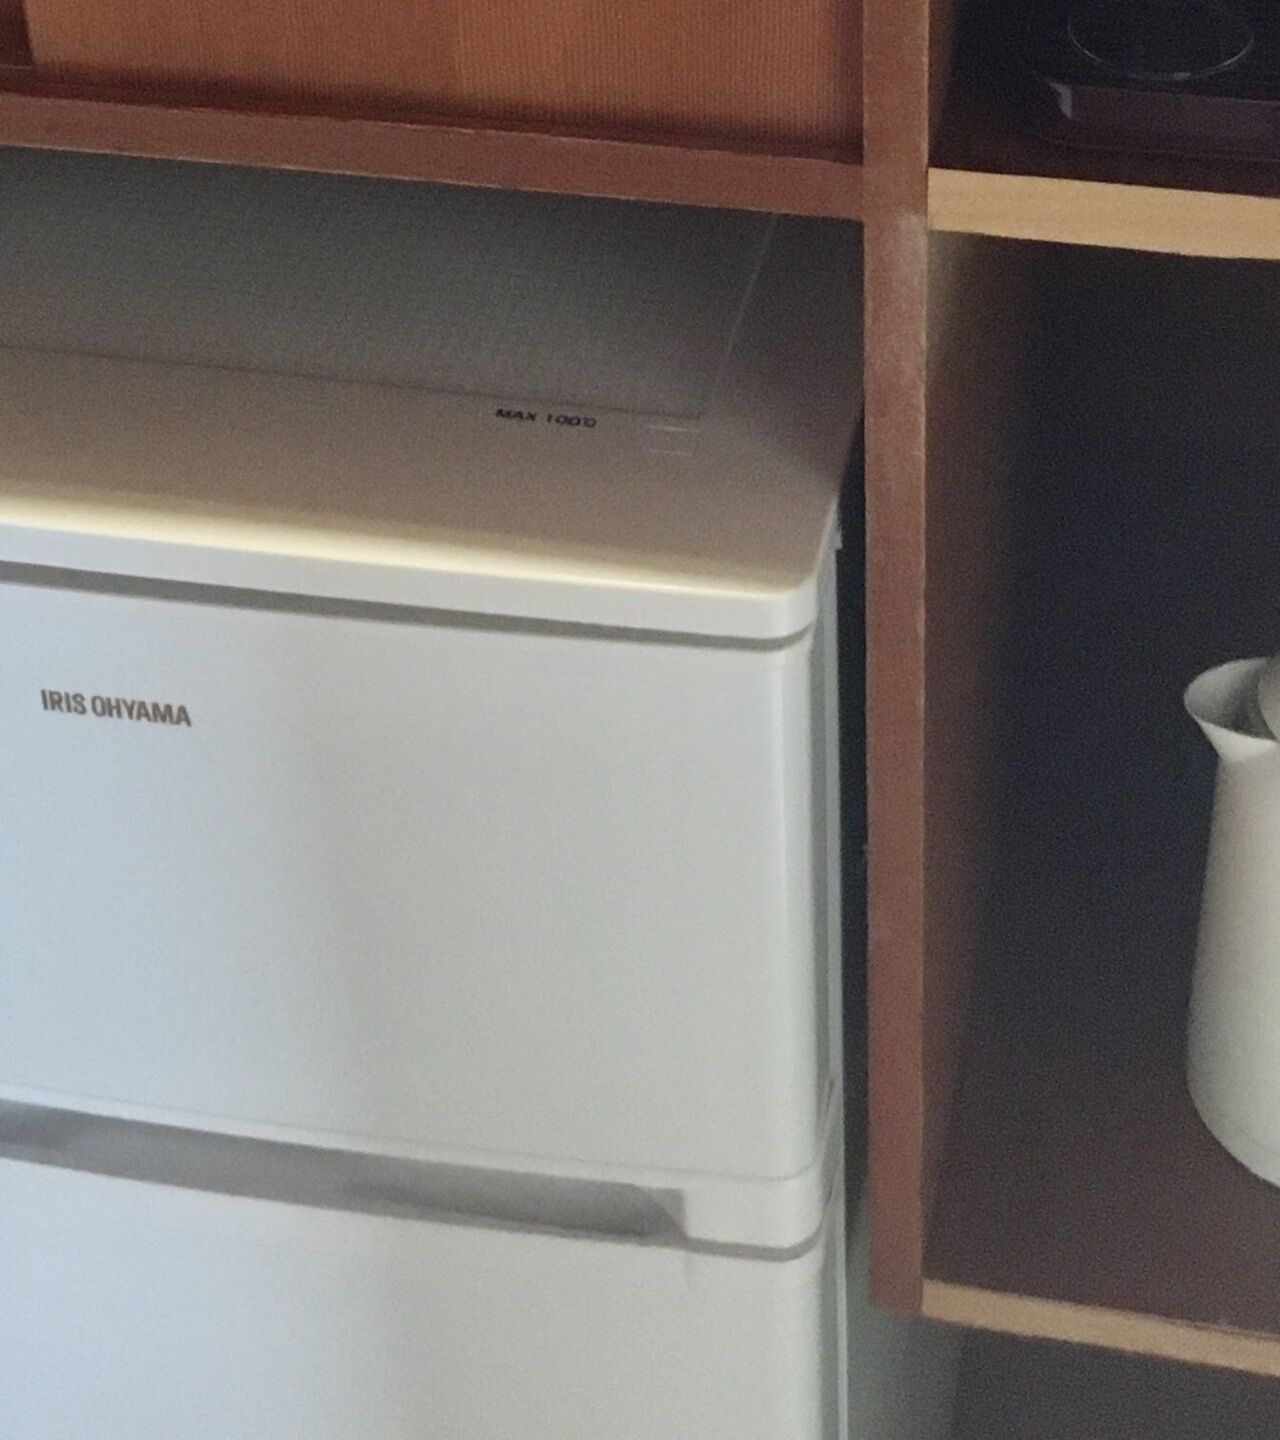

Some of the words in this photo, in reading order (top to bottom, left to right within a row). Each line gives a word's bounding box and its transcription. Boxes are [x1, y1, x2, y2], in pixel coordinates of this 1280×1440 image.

[495, 408, 537, 422] MAX
[40, 689, 87, 716] IRIS
[91, 695, 192, 727] OHYAMA
